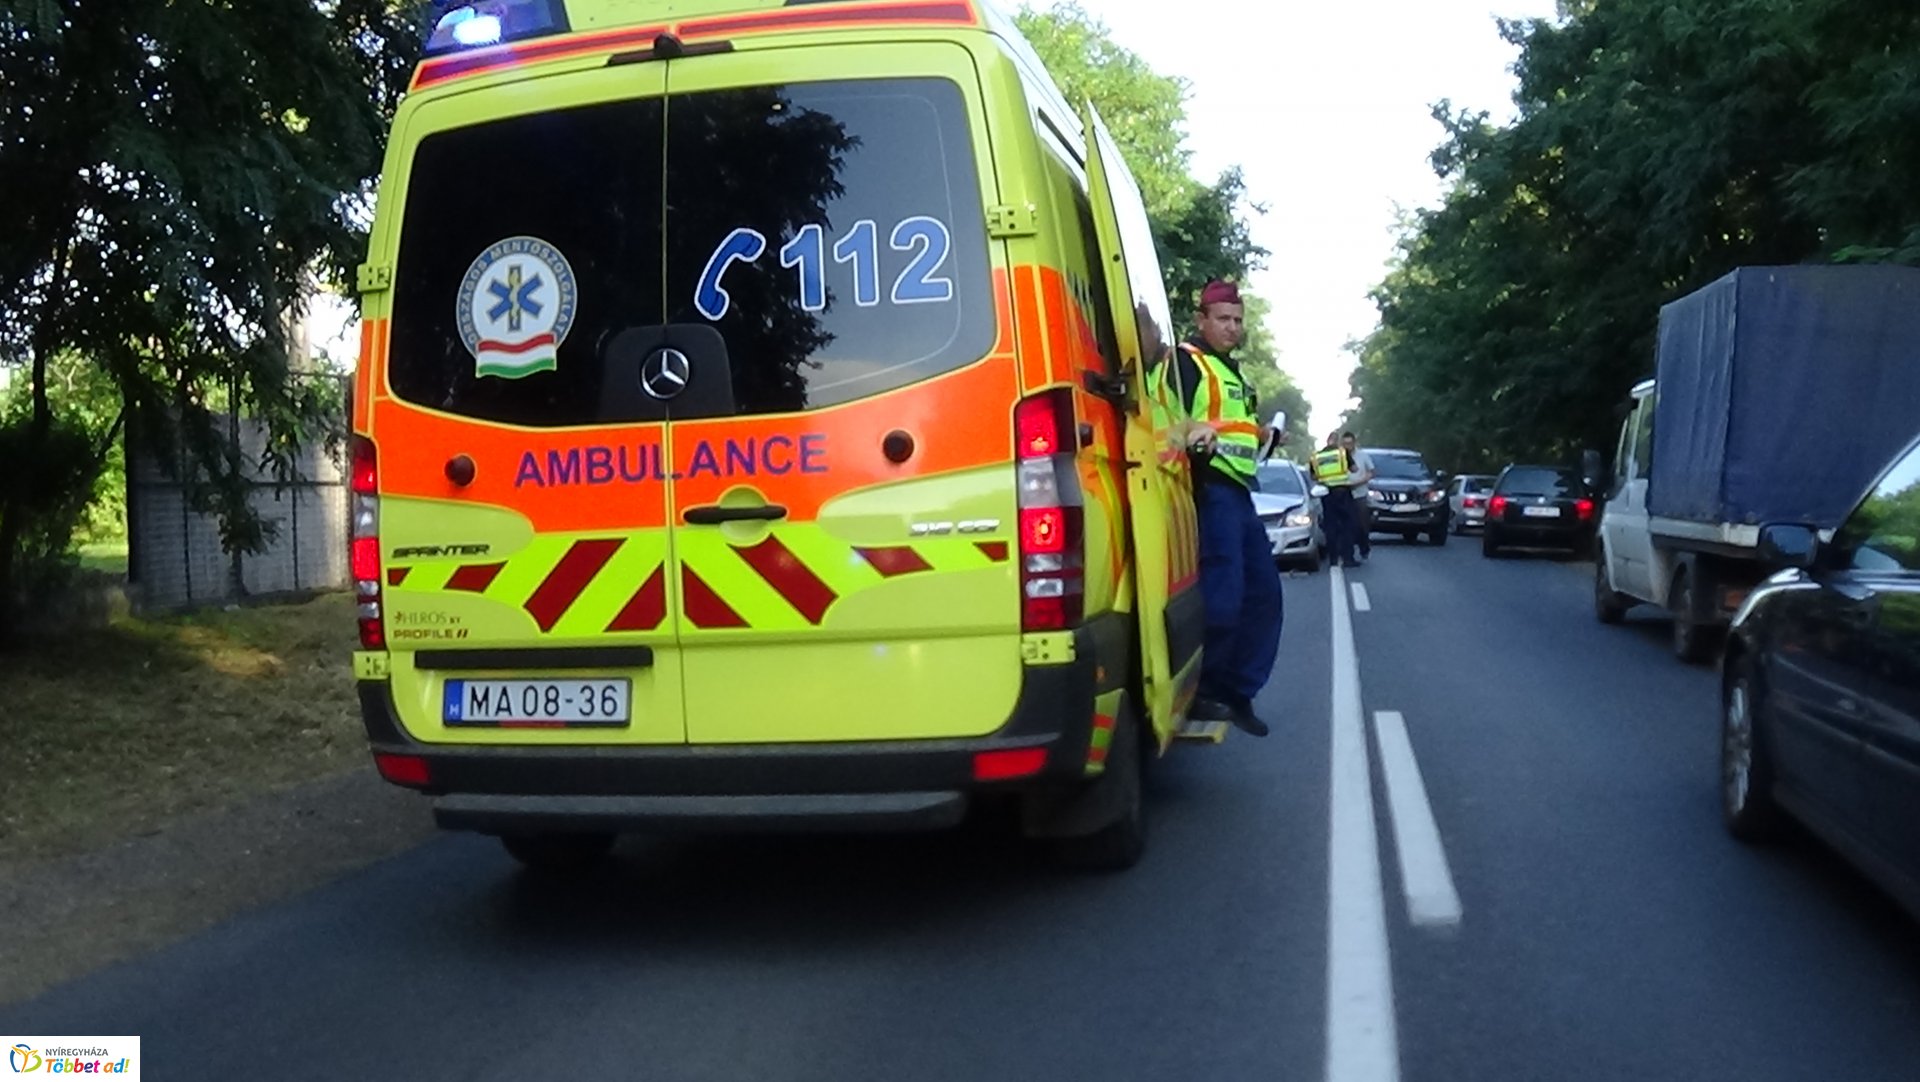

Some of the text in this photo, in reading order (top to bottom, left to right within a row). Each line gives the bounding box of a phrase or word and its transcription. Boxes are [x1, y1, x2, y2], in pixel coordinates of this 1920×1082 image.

[780, 216, 953, 311] 112
[514, 433, 829, 489] AMBULANCE
[392, 544, 491, 559] SPRINTER
[393, 629, 453, 640] PROFILE
[522, 684, 618, 717] 08-36
